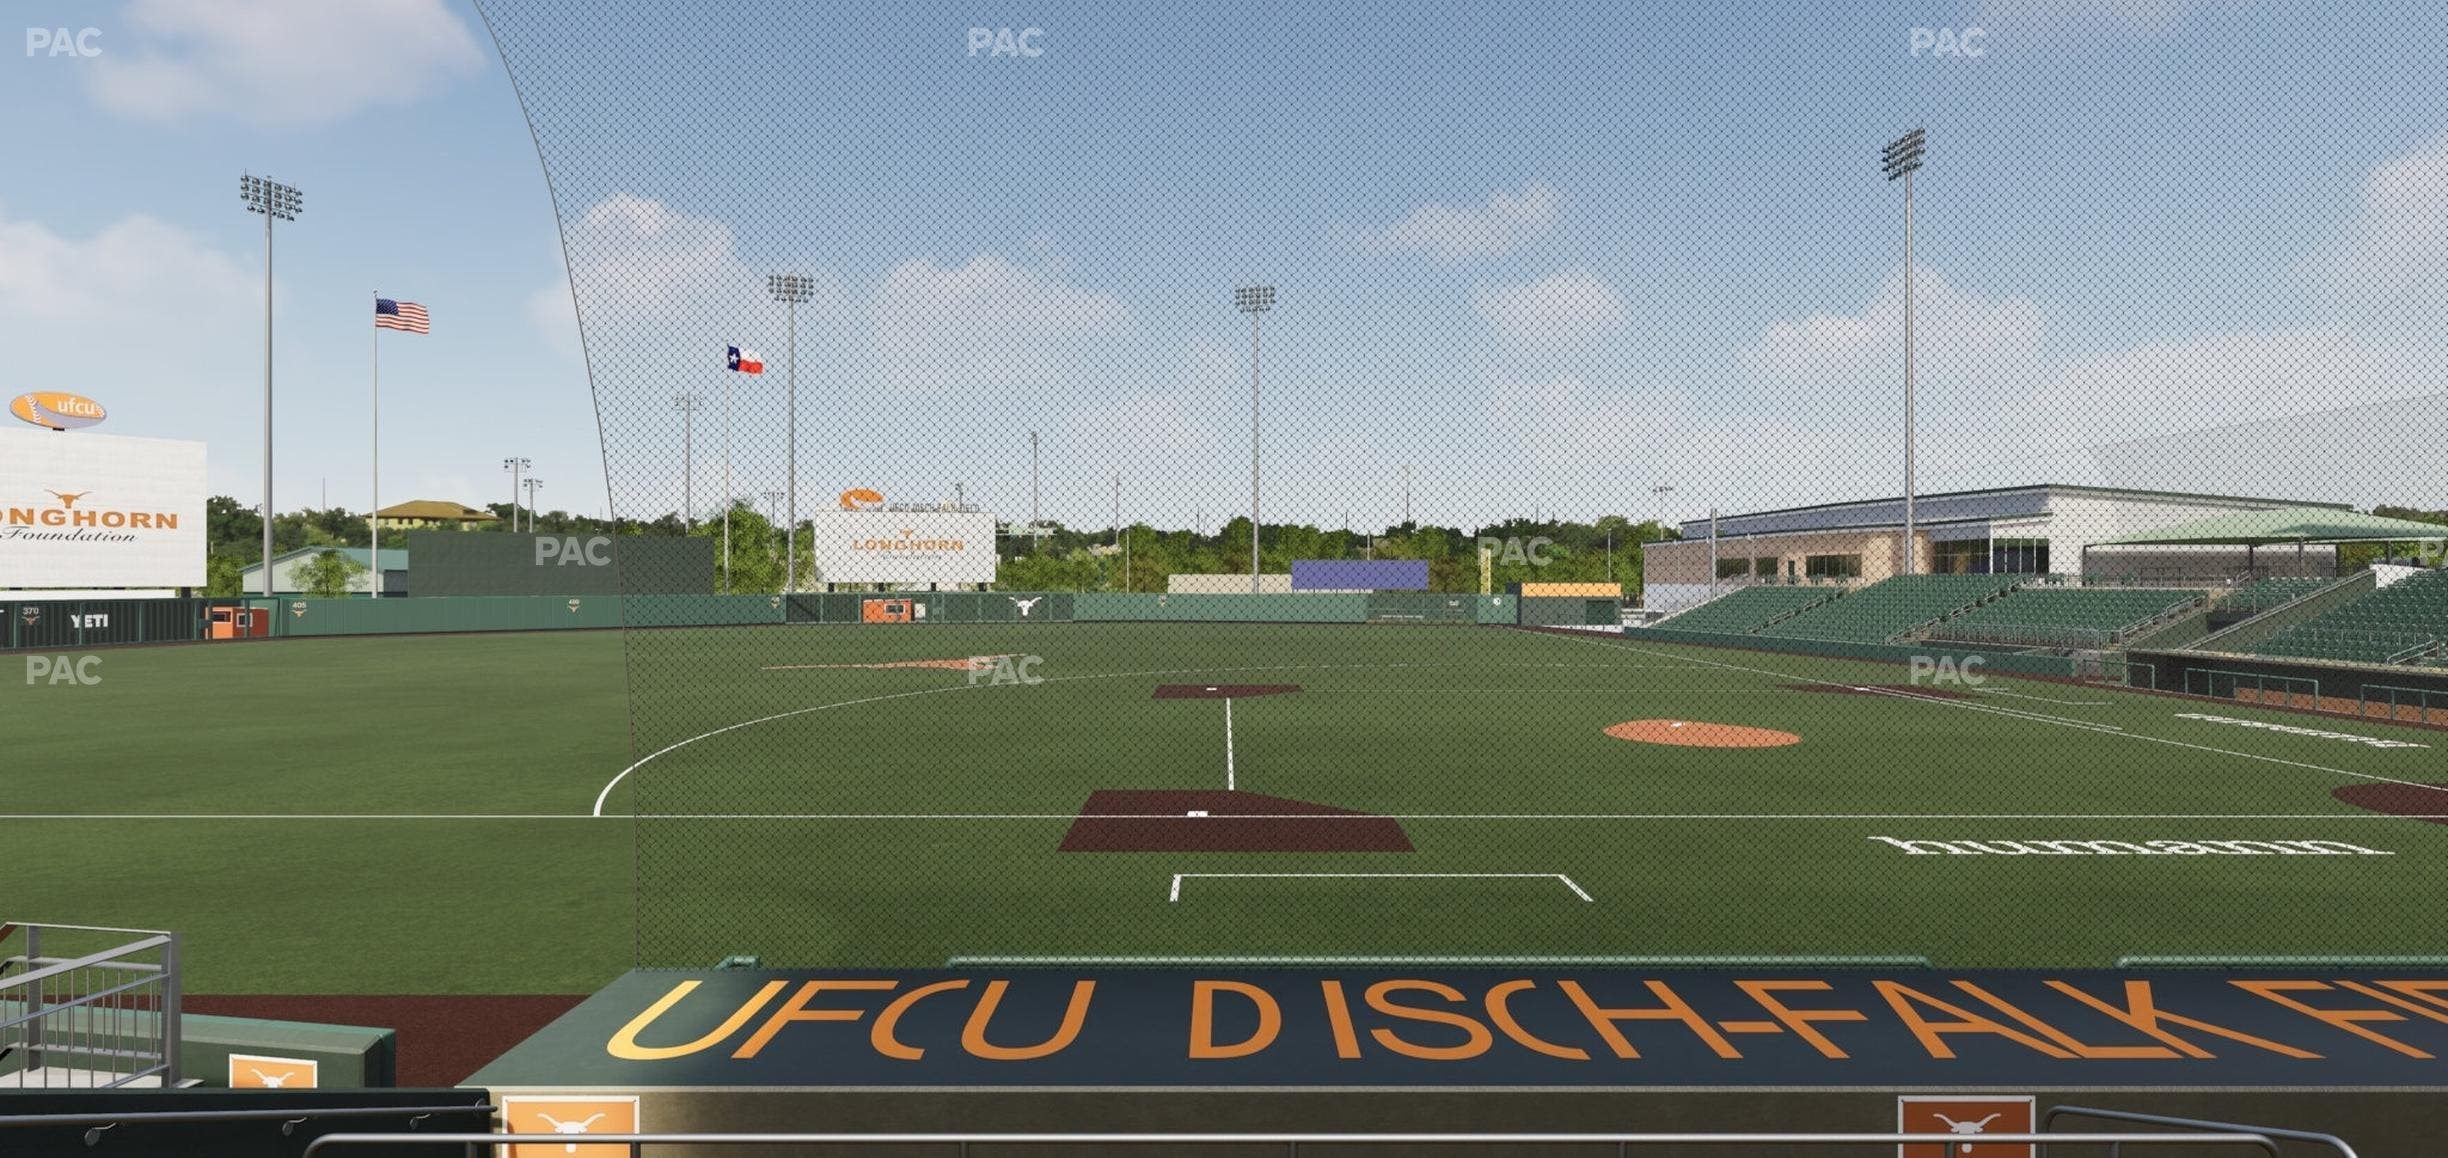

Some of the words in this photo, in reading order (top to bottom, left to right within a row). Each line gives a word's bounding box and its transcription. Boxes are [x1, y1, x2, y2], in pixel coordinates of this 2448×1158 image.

[57, 397, 95, 415] ufcu
[0, 508, 178, 529] NGHORN
[0, 526, 138, 542] Foundation
[852, 539, 964, 552] LONGHORN
[70, 613, 108, 629] YETI
[606, 979, 1095, 1060] UFCU
[1189, 979, 2328, 1060] DISCH-FALK
